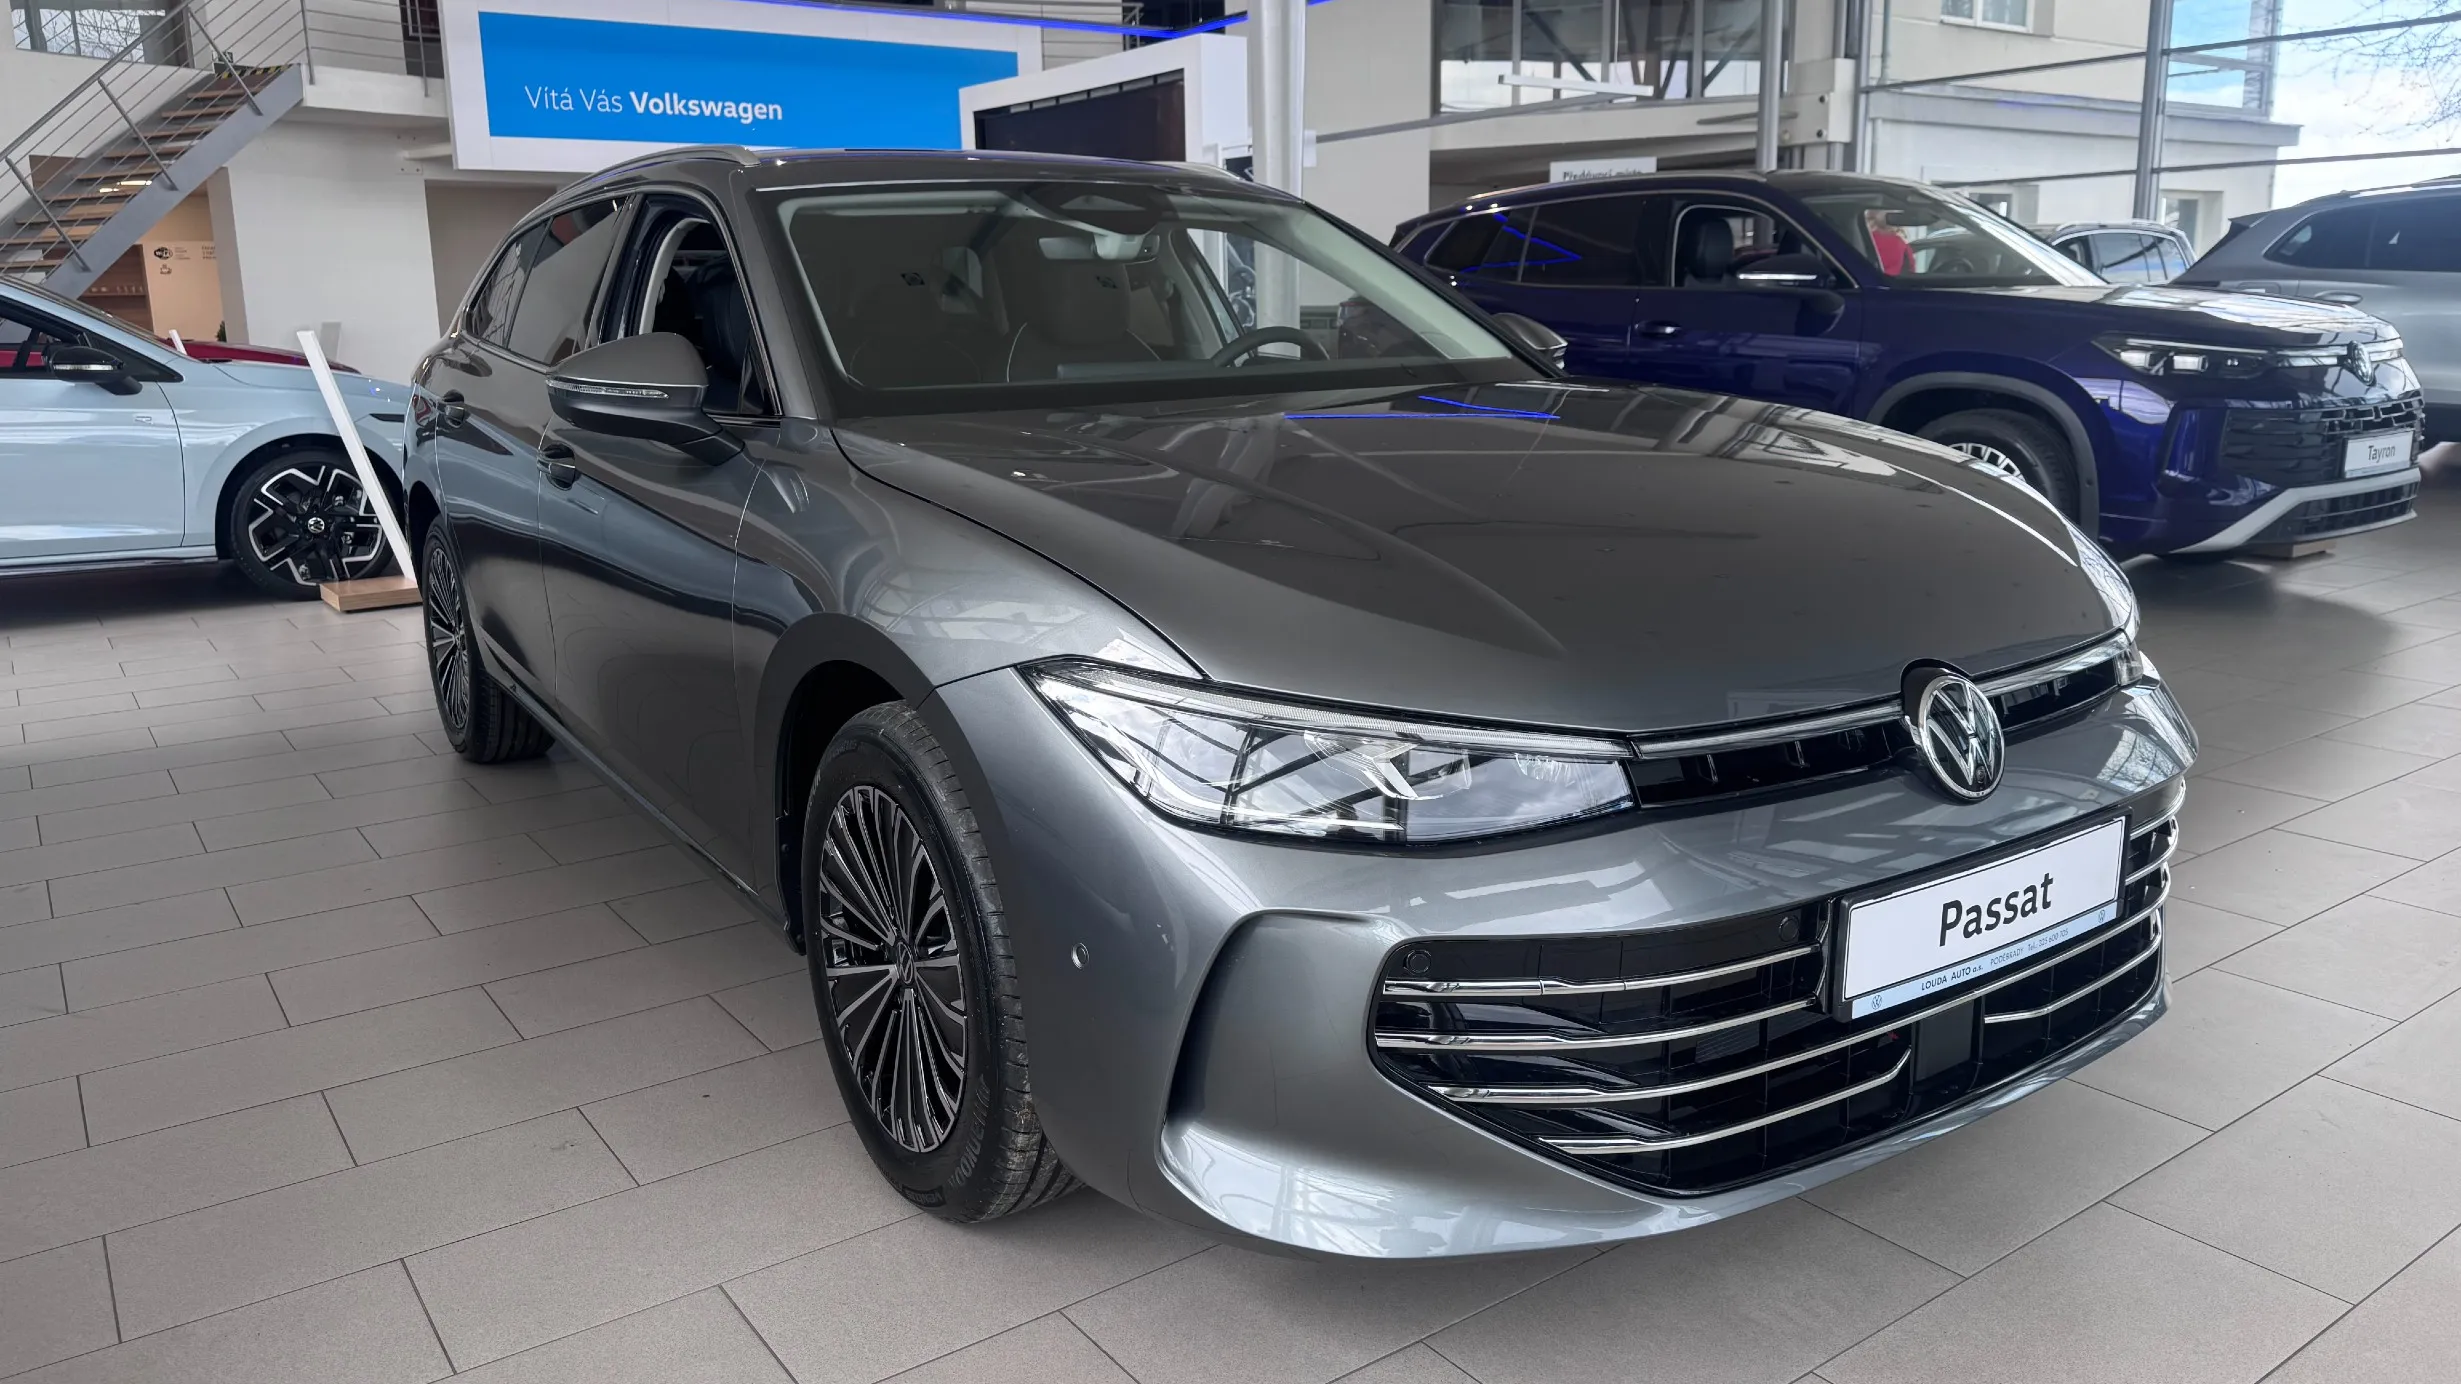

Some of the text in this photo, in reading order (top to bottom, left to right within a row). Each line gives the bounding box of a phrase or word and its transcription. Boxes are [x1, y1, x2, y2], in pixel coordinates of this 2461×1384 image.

[524, 86, 783, 125] Vítá Vás Volkswagen
[2367, 445, 2396, 463] Tayron
[1939, 872, 2054, 947] Passat
[1921, 975, 1948, 991] LOUDA
[1951, 966, 1971, 981] AUTO
